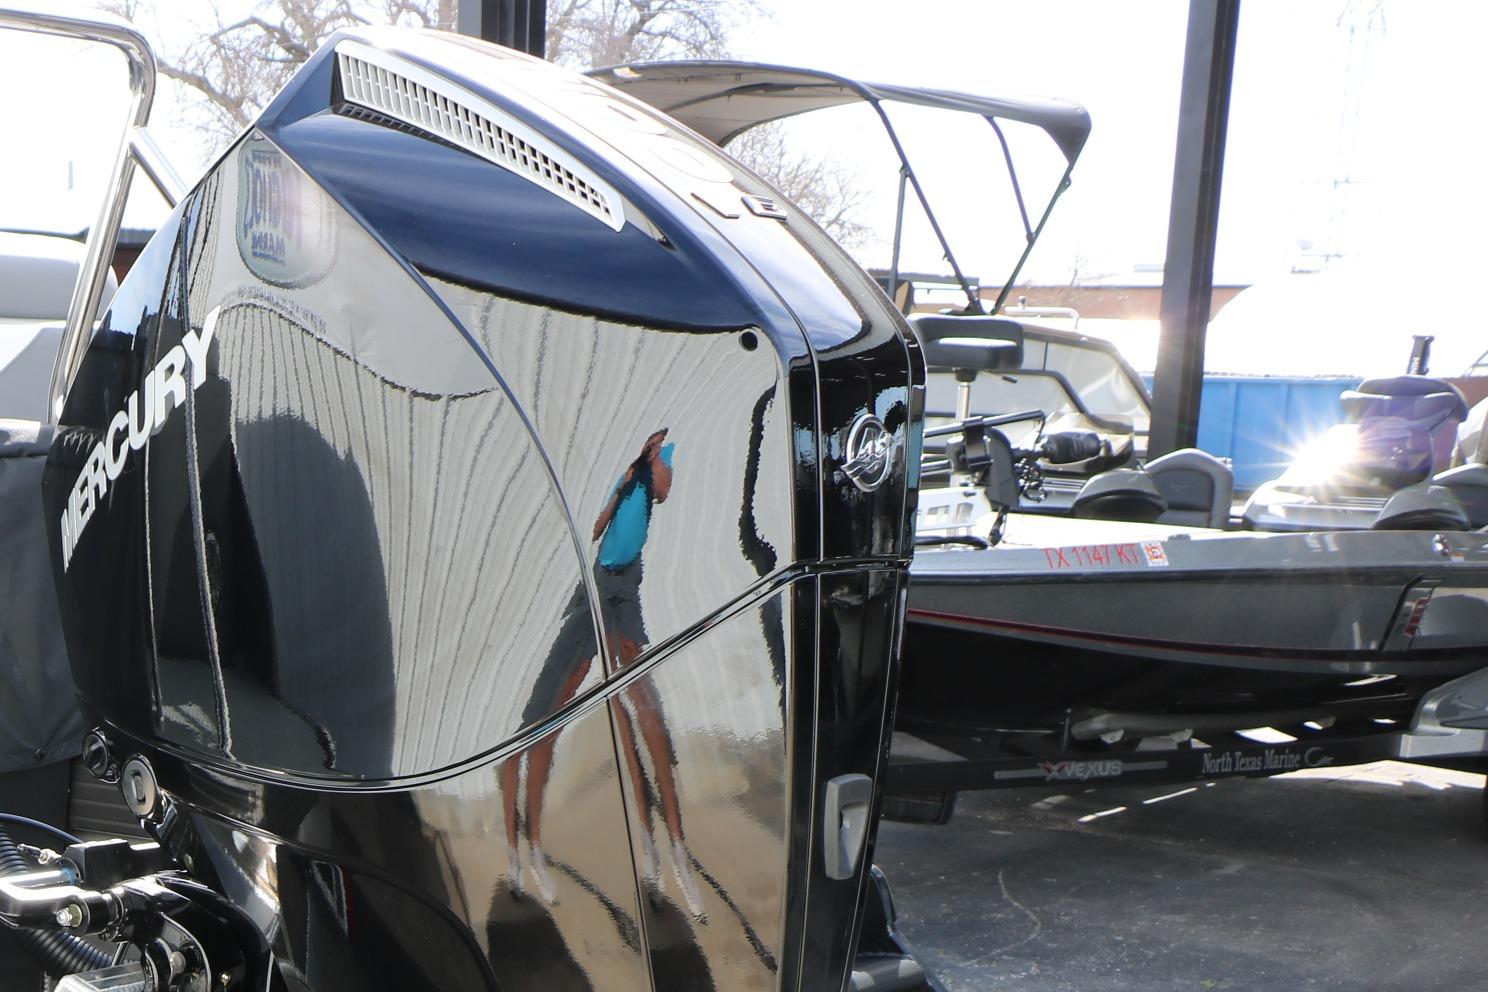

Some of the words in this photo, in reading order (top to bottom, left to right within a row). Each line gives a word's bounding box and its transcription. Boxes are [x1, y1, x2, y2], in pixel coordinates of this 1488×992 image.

[60, 305, 221, 573] MERCURY
[1040, 546, 1070, 569] TX
[1113, 542, 1140, 565] KT
[1202, 751, 1232, 773] North
[1233, 751, 1263, 772] Texas
[1263, 748, 1301, 770] Marine
